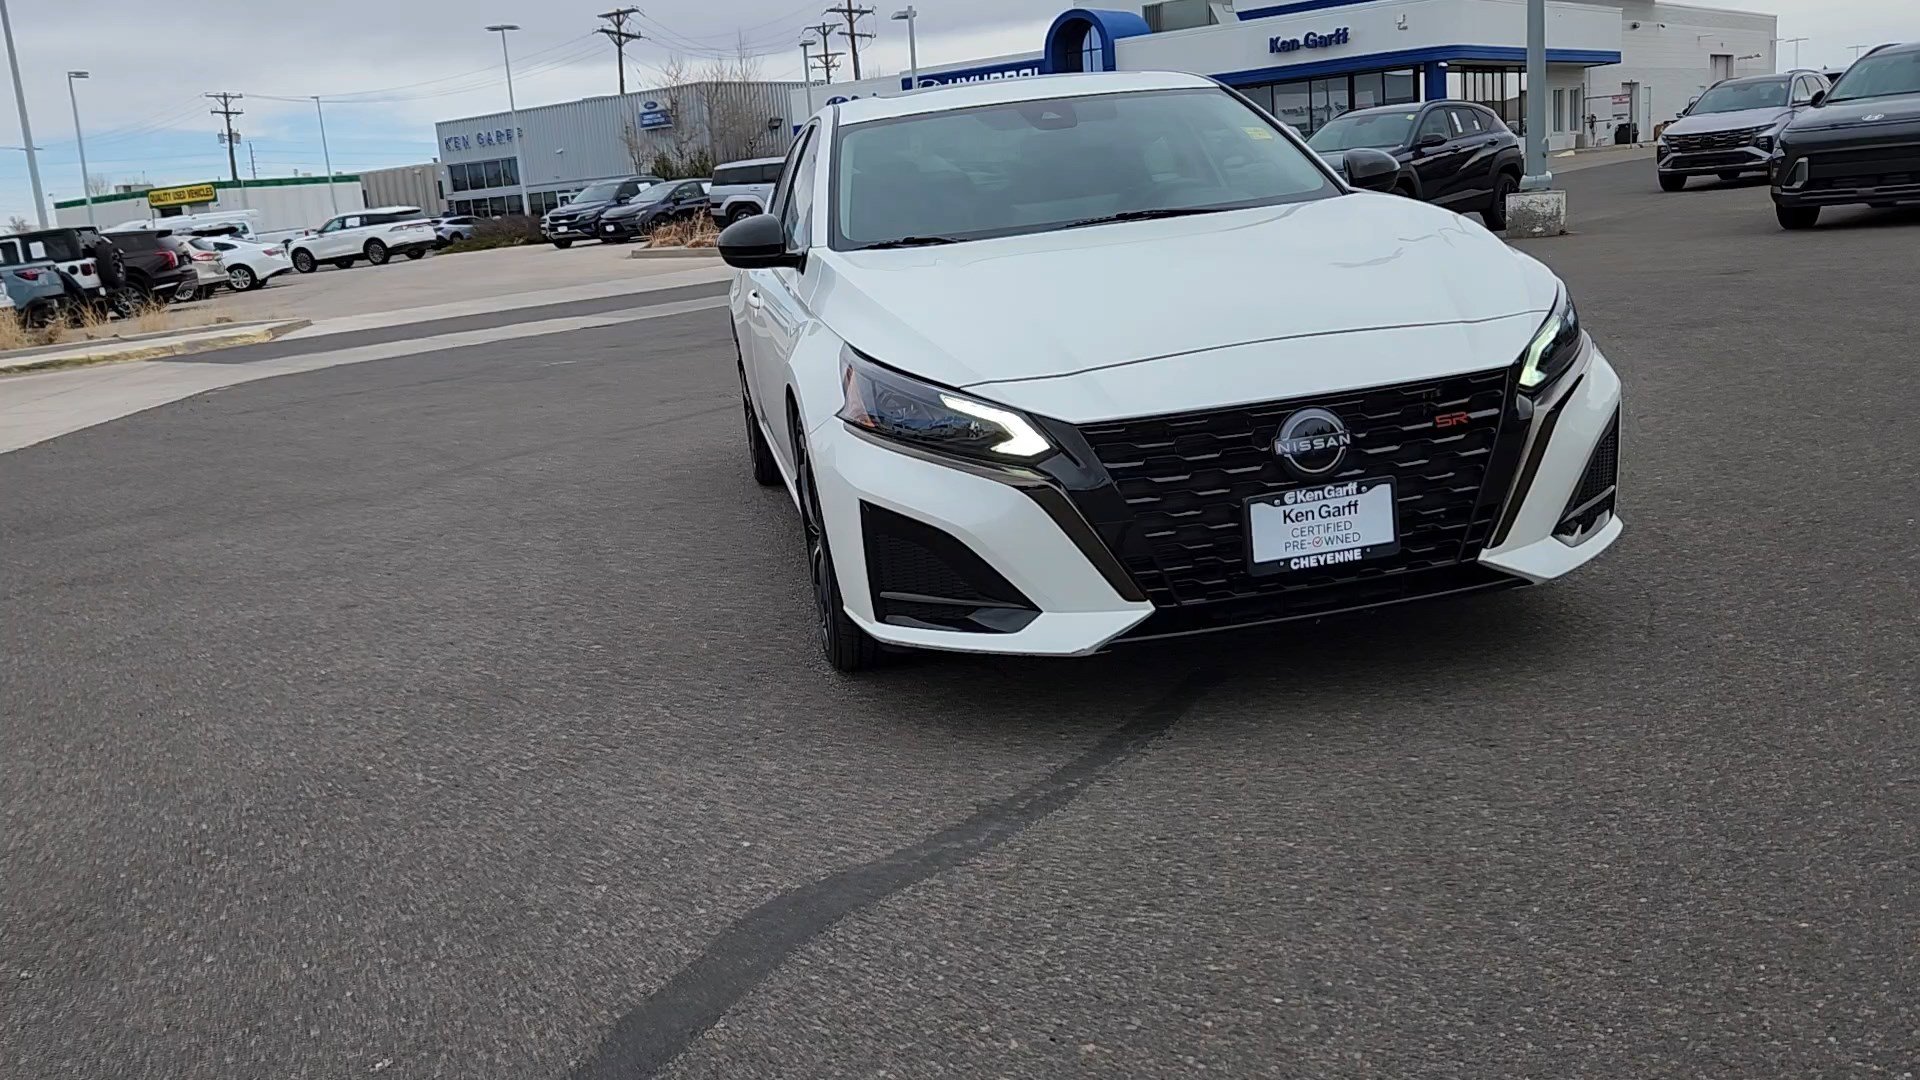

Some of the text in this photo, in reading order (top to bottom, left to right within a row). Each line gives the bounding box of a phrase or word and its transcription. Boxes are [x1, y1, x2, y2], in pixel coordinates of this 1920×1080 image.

[1269, 27, 1349, 53] Ken Garff
[444, 134, 471, 152] KEN
[1435, 411, 1468, 428] SR
[1277, 433, 1351, 454] NISSAN
[1296, 482, 1358, 503] Ken Garff
[1282, 500, 1359, 524] Ken Garff
[1291, 520, 1353, 538] CERTIFIED
[1290, 548, 1362, 570] CHEYENNE
